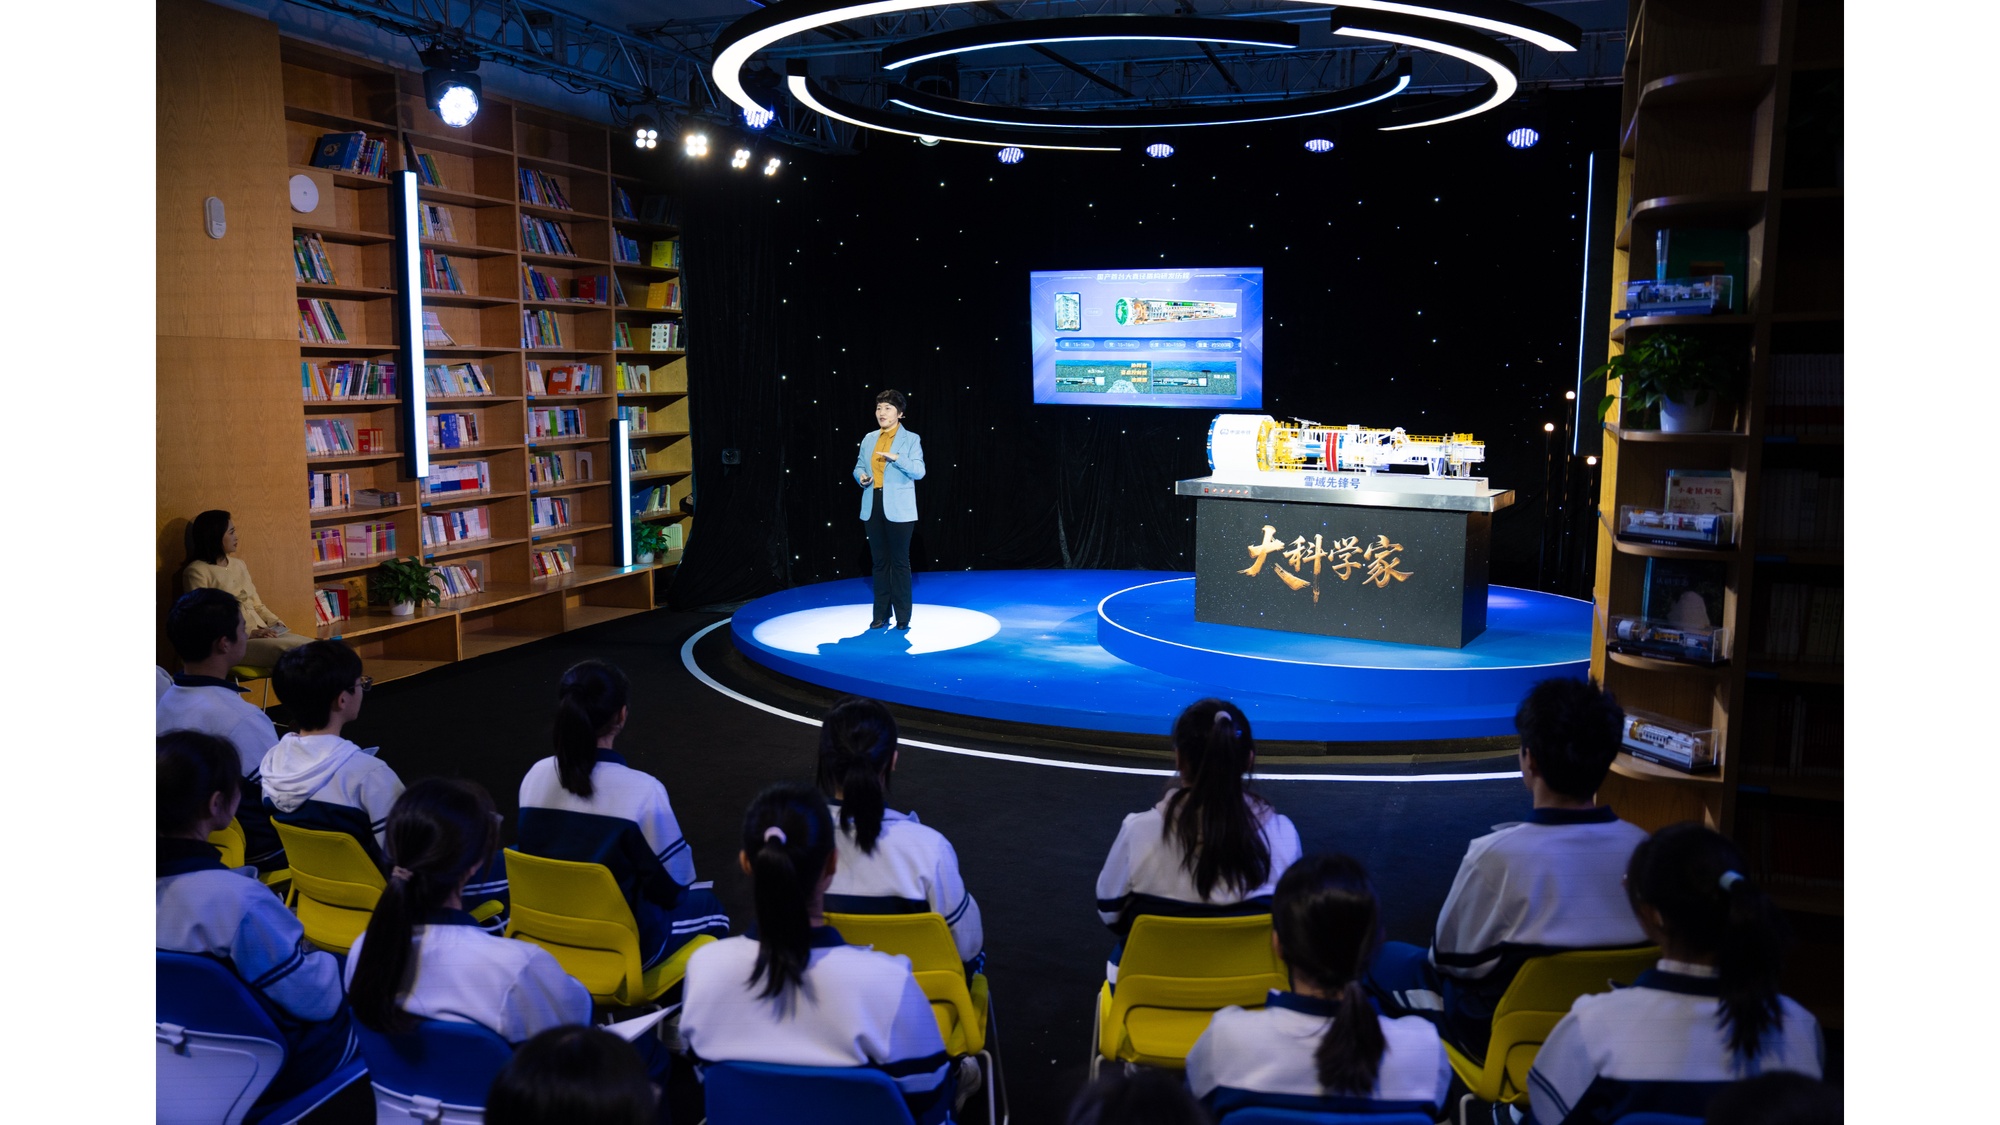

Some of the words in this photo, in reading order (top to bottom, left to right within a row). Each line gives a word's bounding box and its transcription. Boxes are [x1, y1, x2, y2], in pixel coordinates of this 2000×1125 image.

[1303, 475, 1361, 490] 雪域先锋号
[1237, 524, 1415, 607] 大科学家
